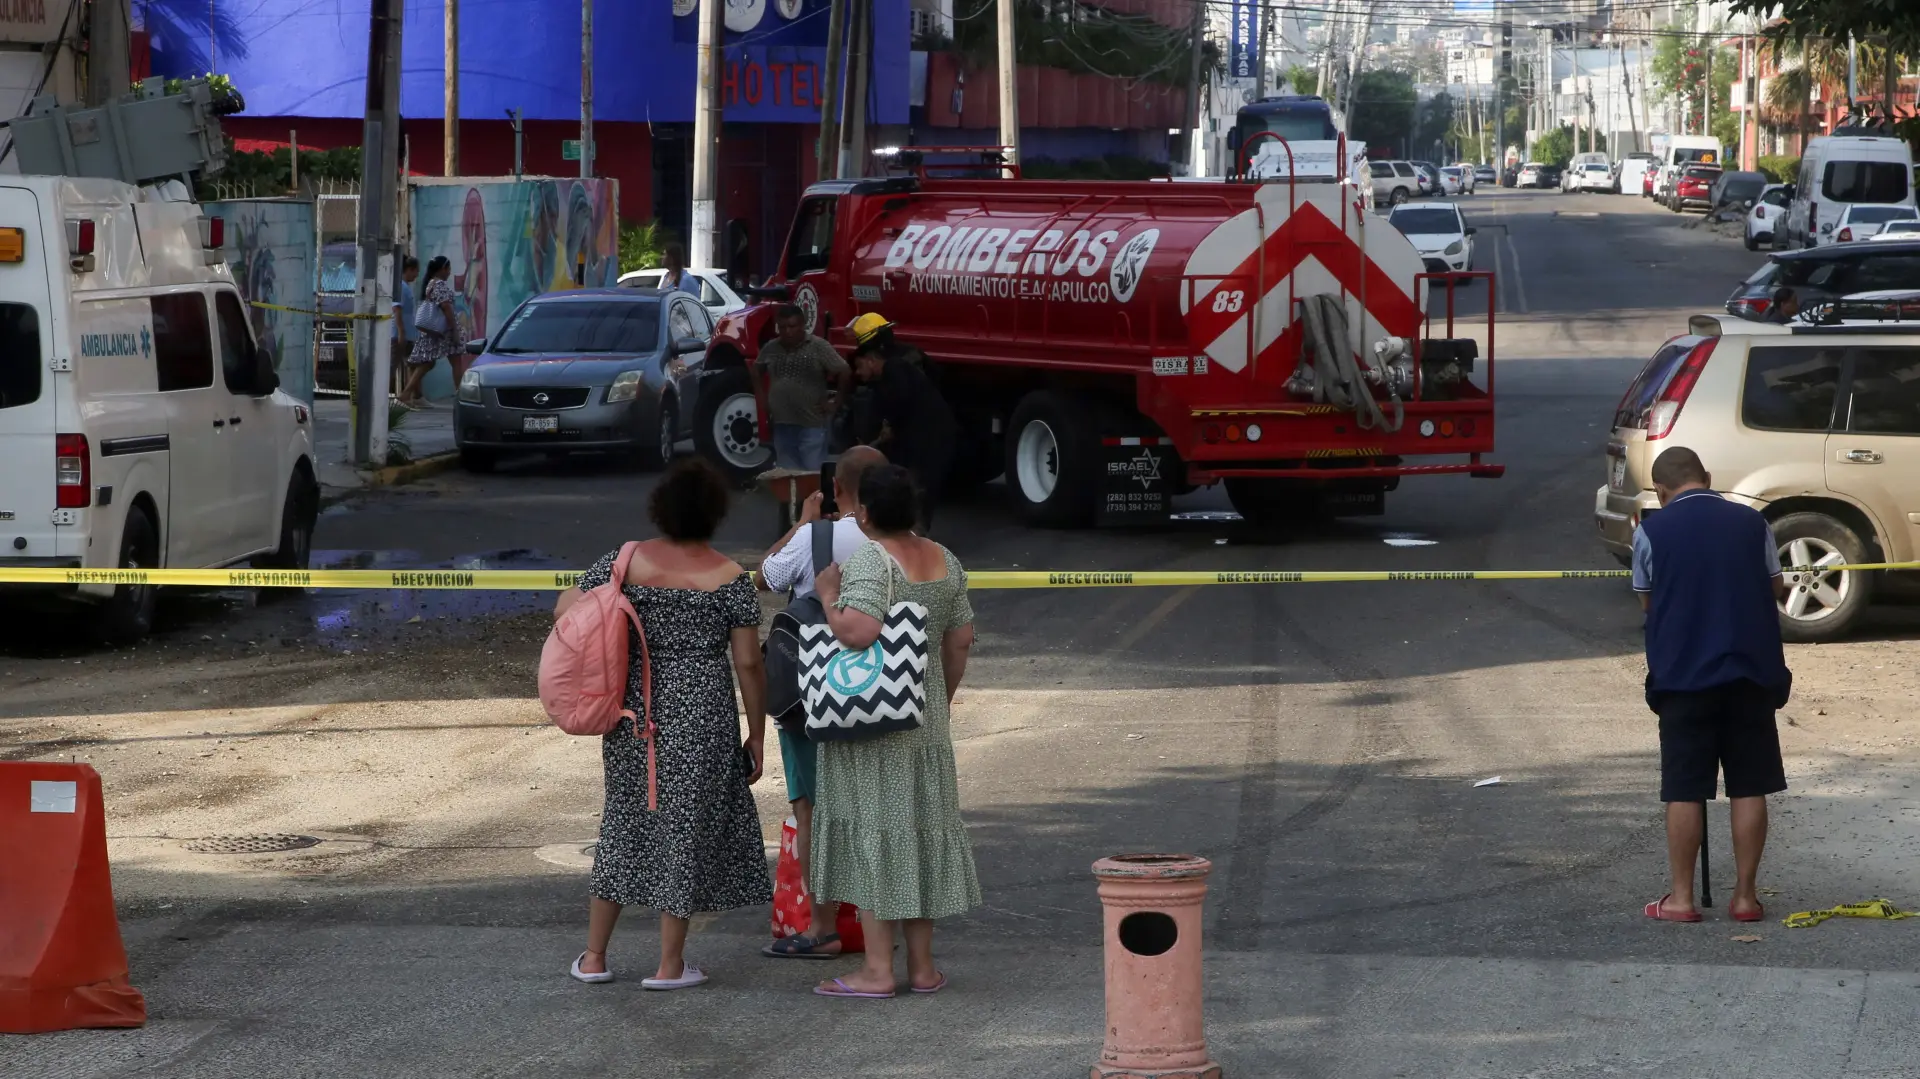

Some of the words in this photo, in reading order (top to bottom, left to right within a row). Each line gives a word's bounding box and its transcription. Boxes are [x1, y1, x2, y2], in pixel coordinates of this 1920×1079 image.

[721, 62, 823, 107] HOTEL
[884, 224, 1118, 277] BOMBEROS
[909, 273, 1008, 298] AYUNTAMIENTO
[1212, 290, 1244, 313] 83
[81, 334, 138, 356] AMBULANCIA
[1107, 462, 1151, 471] ISRAEL
